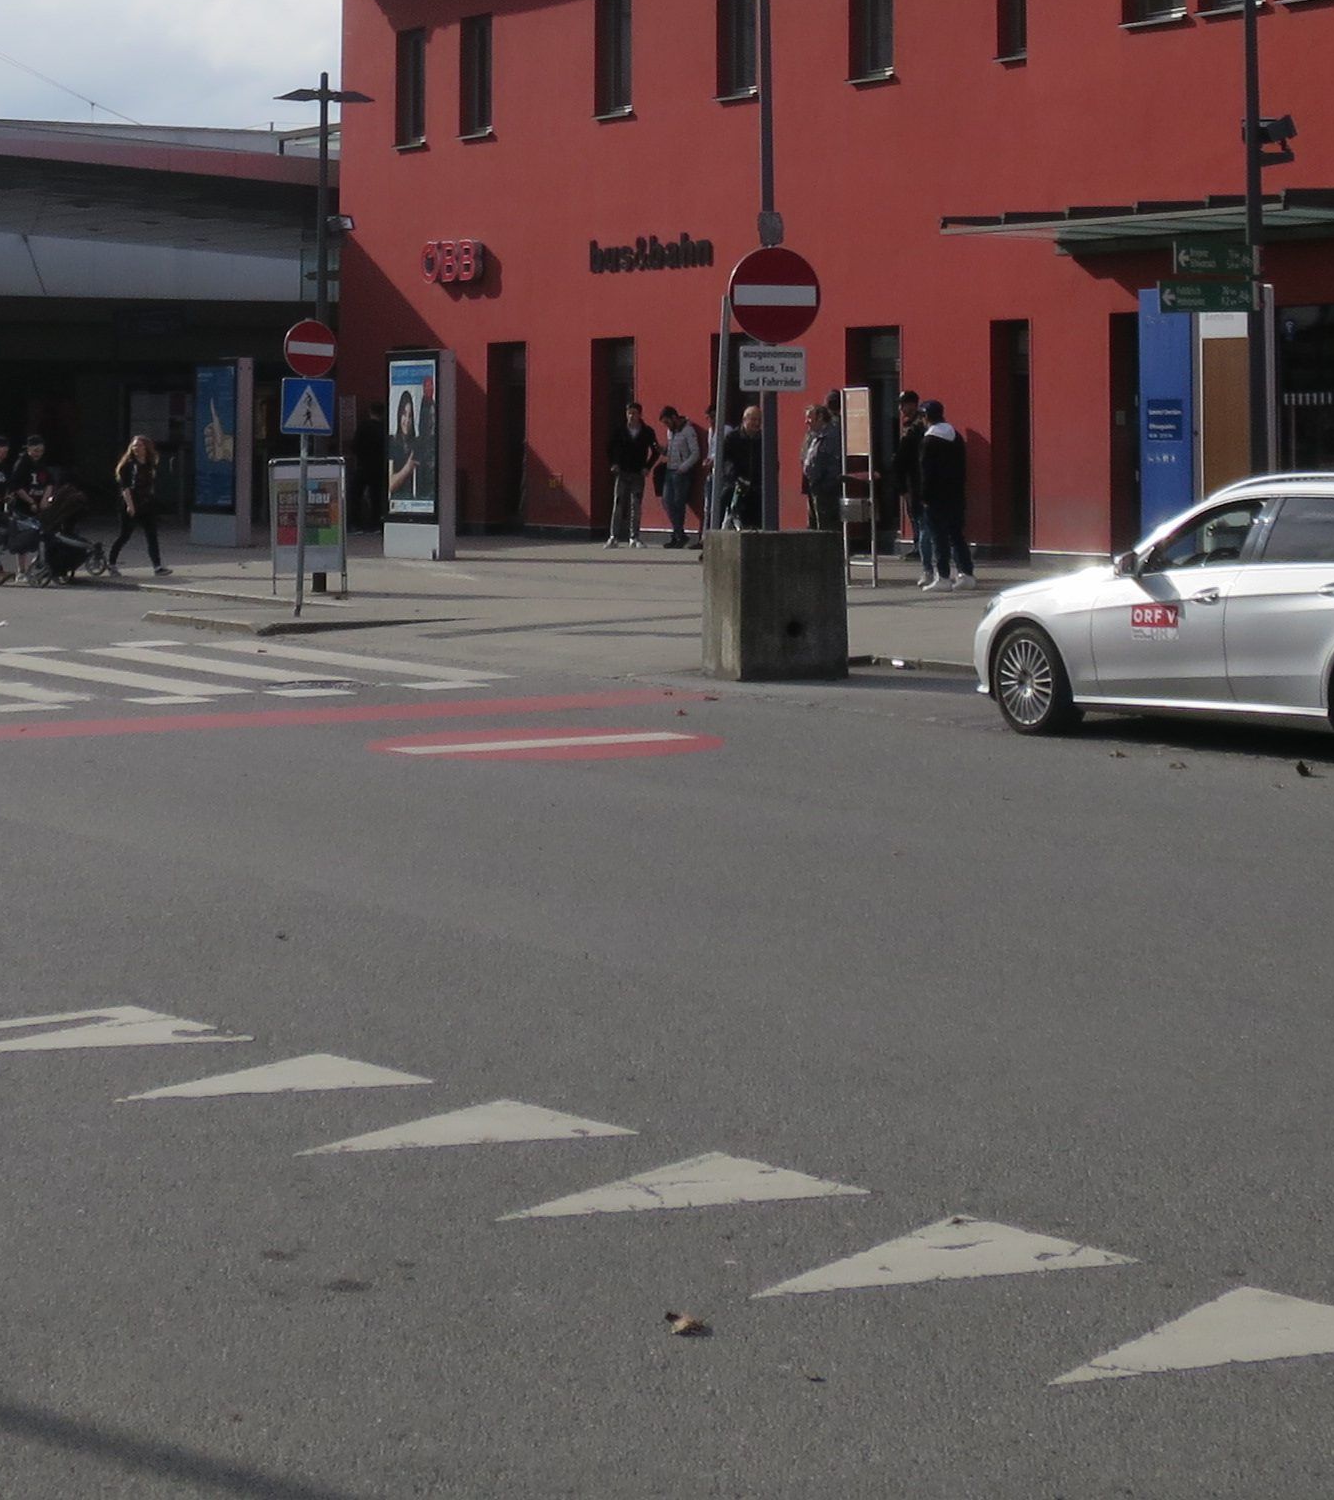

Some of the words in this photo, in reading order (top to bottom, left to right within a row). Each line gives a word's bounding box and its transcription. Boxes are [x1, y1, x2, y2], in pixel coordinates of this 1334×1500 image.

[589, 232, 714, 274] bus&bahn
[779, 362, 797, 372] Taxi
[744, 377, 760, 386] und
[1133, 608, 1163, 624] ORF
[1166, 609, 1177, 624] V
